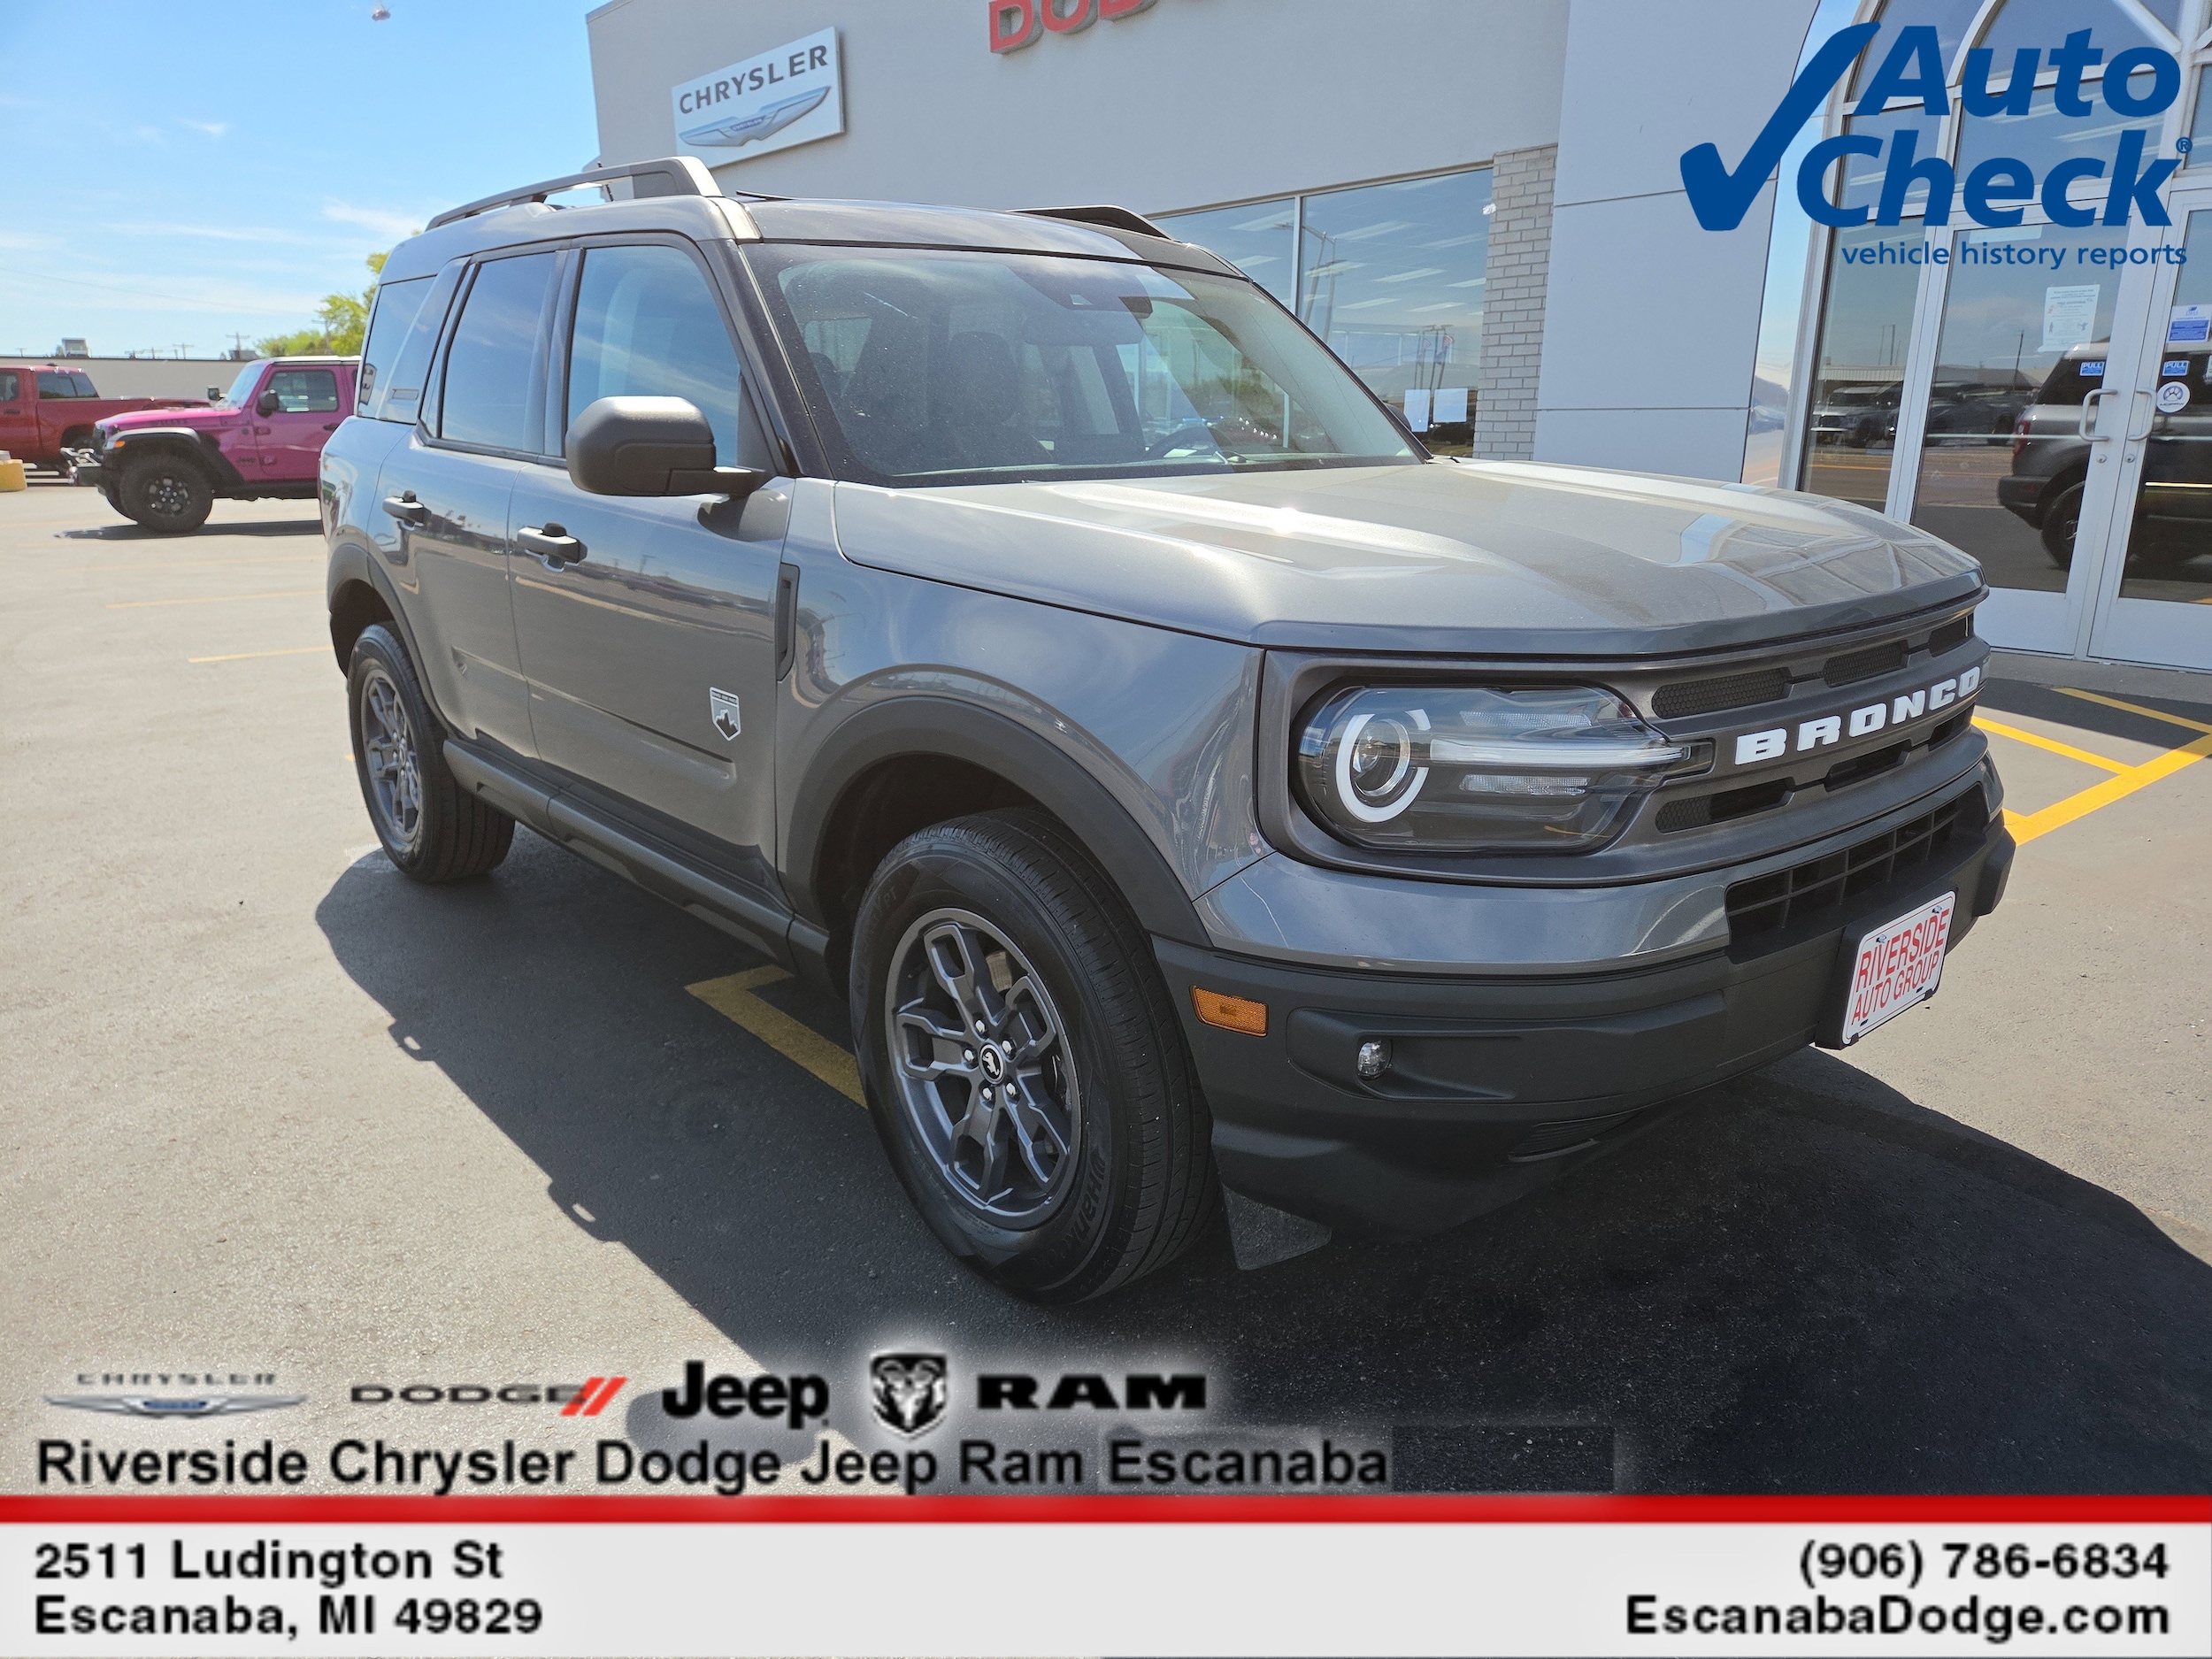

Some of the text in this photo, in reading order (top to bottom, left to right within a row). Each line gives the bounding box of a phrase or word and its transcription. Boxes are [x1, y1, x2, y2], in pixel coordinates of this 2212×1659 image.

[680, 45, 829, 115] CHRYSLER
[1735, 666, 1981, 766] BRONCO
[1851, 949, 1940, 1025] AUTO GROUP
[1856, 909, 1950, 993] RIVERSIDE
